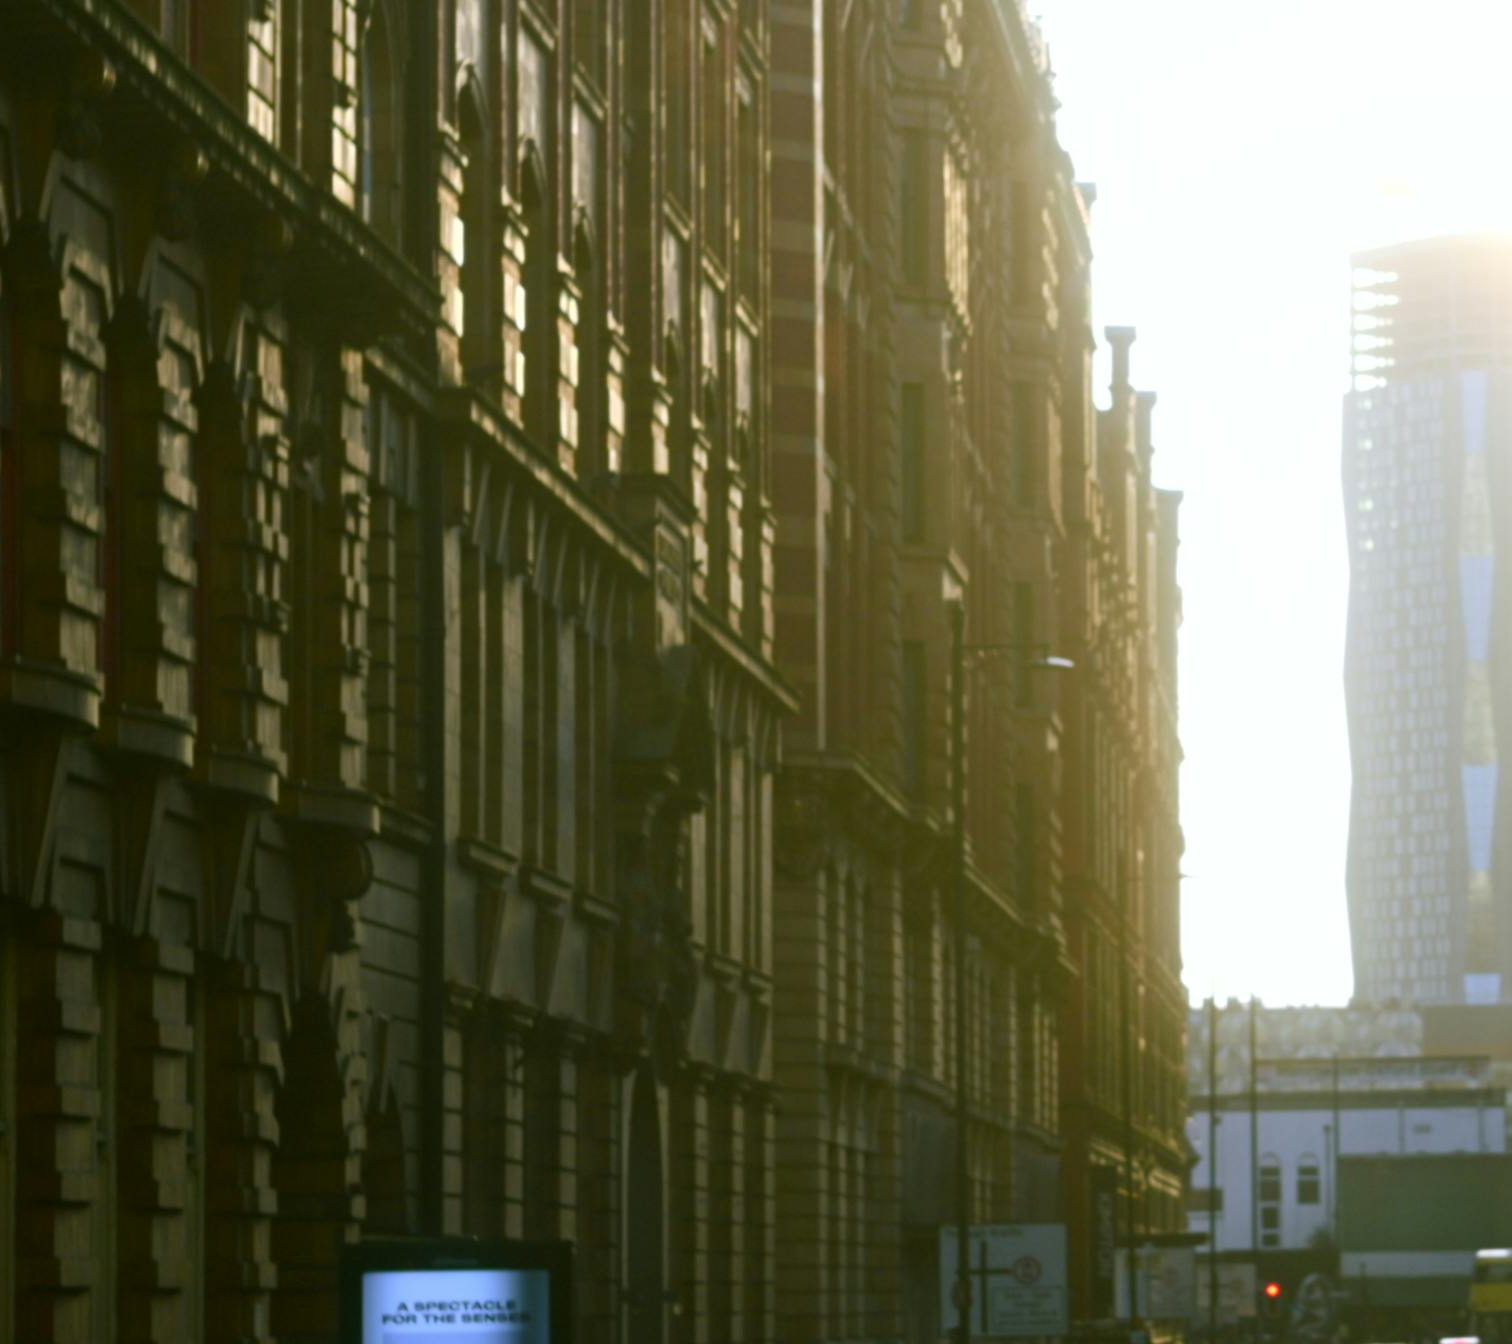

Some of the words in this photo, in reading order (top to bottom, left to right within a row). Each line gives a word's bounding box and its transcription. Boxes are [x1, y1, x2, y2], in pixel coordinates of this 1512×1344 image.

[397, 1301, 409, 1312] A
[414, 1299, 516, 1312] SPECTACLE
[382, 1313, 417, 1325] FOR
[424, 1313, 456, 1324] THE
[461, 1311, 532, 1324] SENSES
